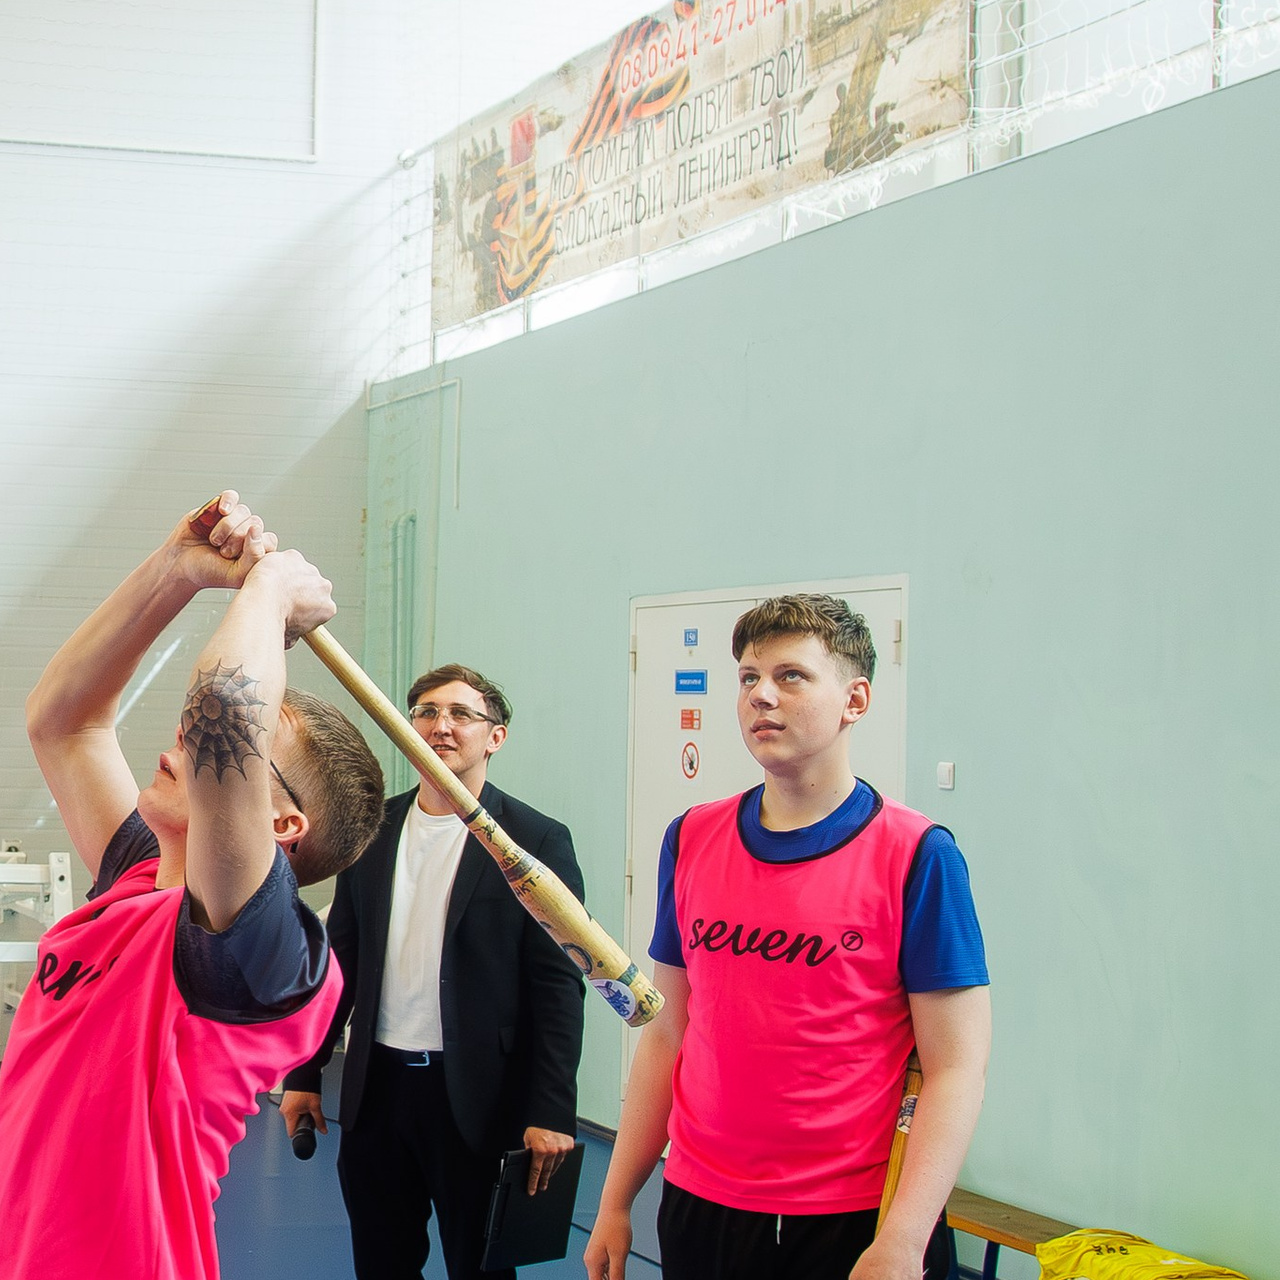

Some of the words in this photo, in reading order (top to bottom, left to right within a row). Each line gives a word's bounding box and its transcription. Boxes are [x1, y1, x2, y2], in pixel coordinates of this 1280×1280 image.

[550, 153, 578, 205] МЫ
[581, 115, 657, 191] ПОМНИМ
[665, 74, 740, 153] ПОДВИГ
[553, 168, 665, 256] БЛОКАДНЫЙ
[673, 107, 799, 209] ЛЕНИНГРАД!
[688, 918, 838, 967] seven
